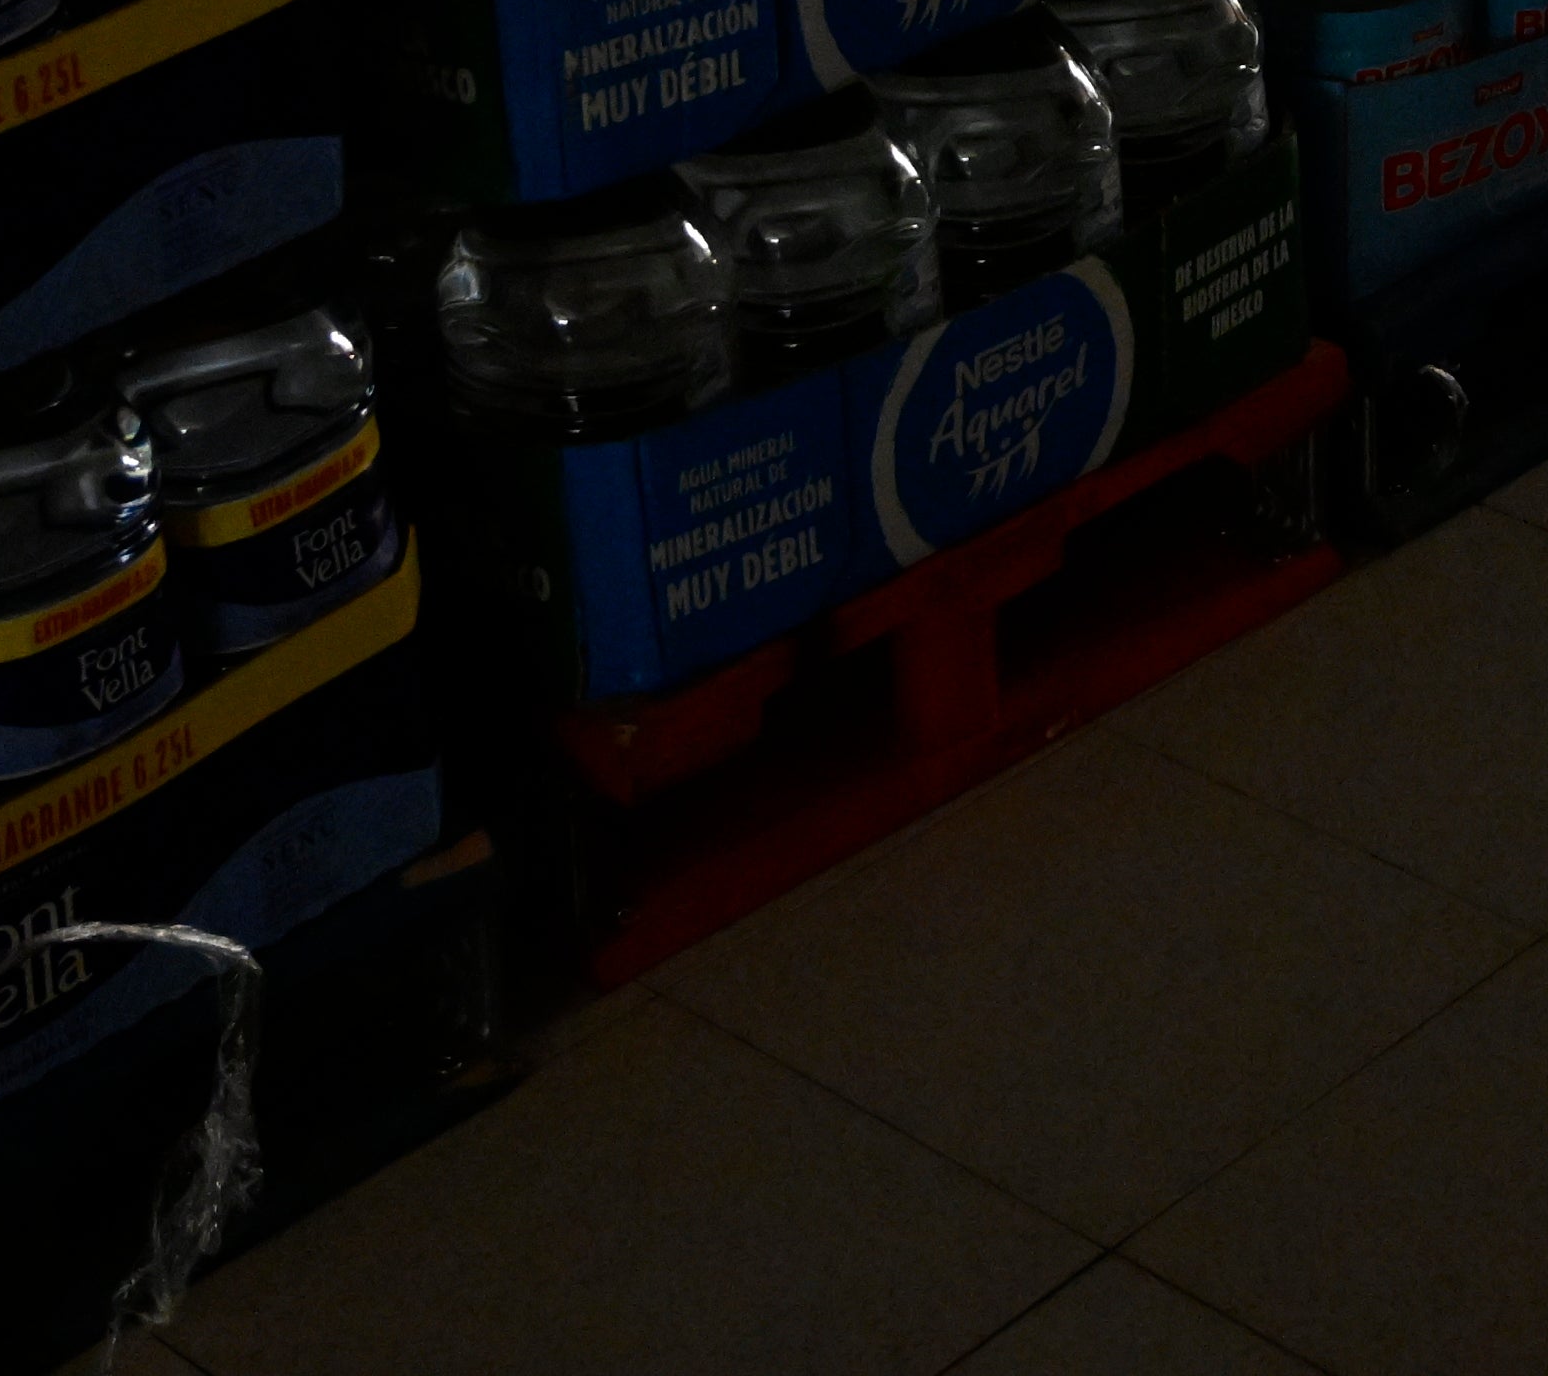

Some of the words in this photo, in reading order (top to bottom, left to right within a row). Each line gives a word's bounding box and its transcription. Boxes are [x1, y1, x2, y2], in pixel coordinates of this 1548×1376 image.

[579, 72, 650, 133] MUY
[658, 47, 747, 110] DÉBIL
[954, 313, 1067, 400] Nestlé
[927, 340, 1089, 466] Aquarel
[677, 457, 723, 494] AGUA
[725, 429, 797, 473] MINERAL
[688, 469, 763, 516] NATURAL
[291, 507, 358, 565] Font
[649, 472, 833, 572] MINERALIZACIÓN
[294, 537, 367, 591] Vella
[664, 559, 732, 623] MUY
[740, 524, 824, 592] DÉBIL
[78, 624, 149, 683] Font
[81, 657, 155, 711] Vella
